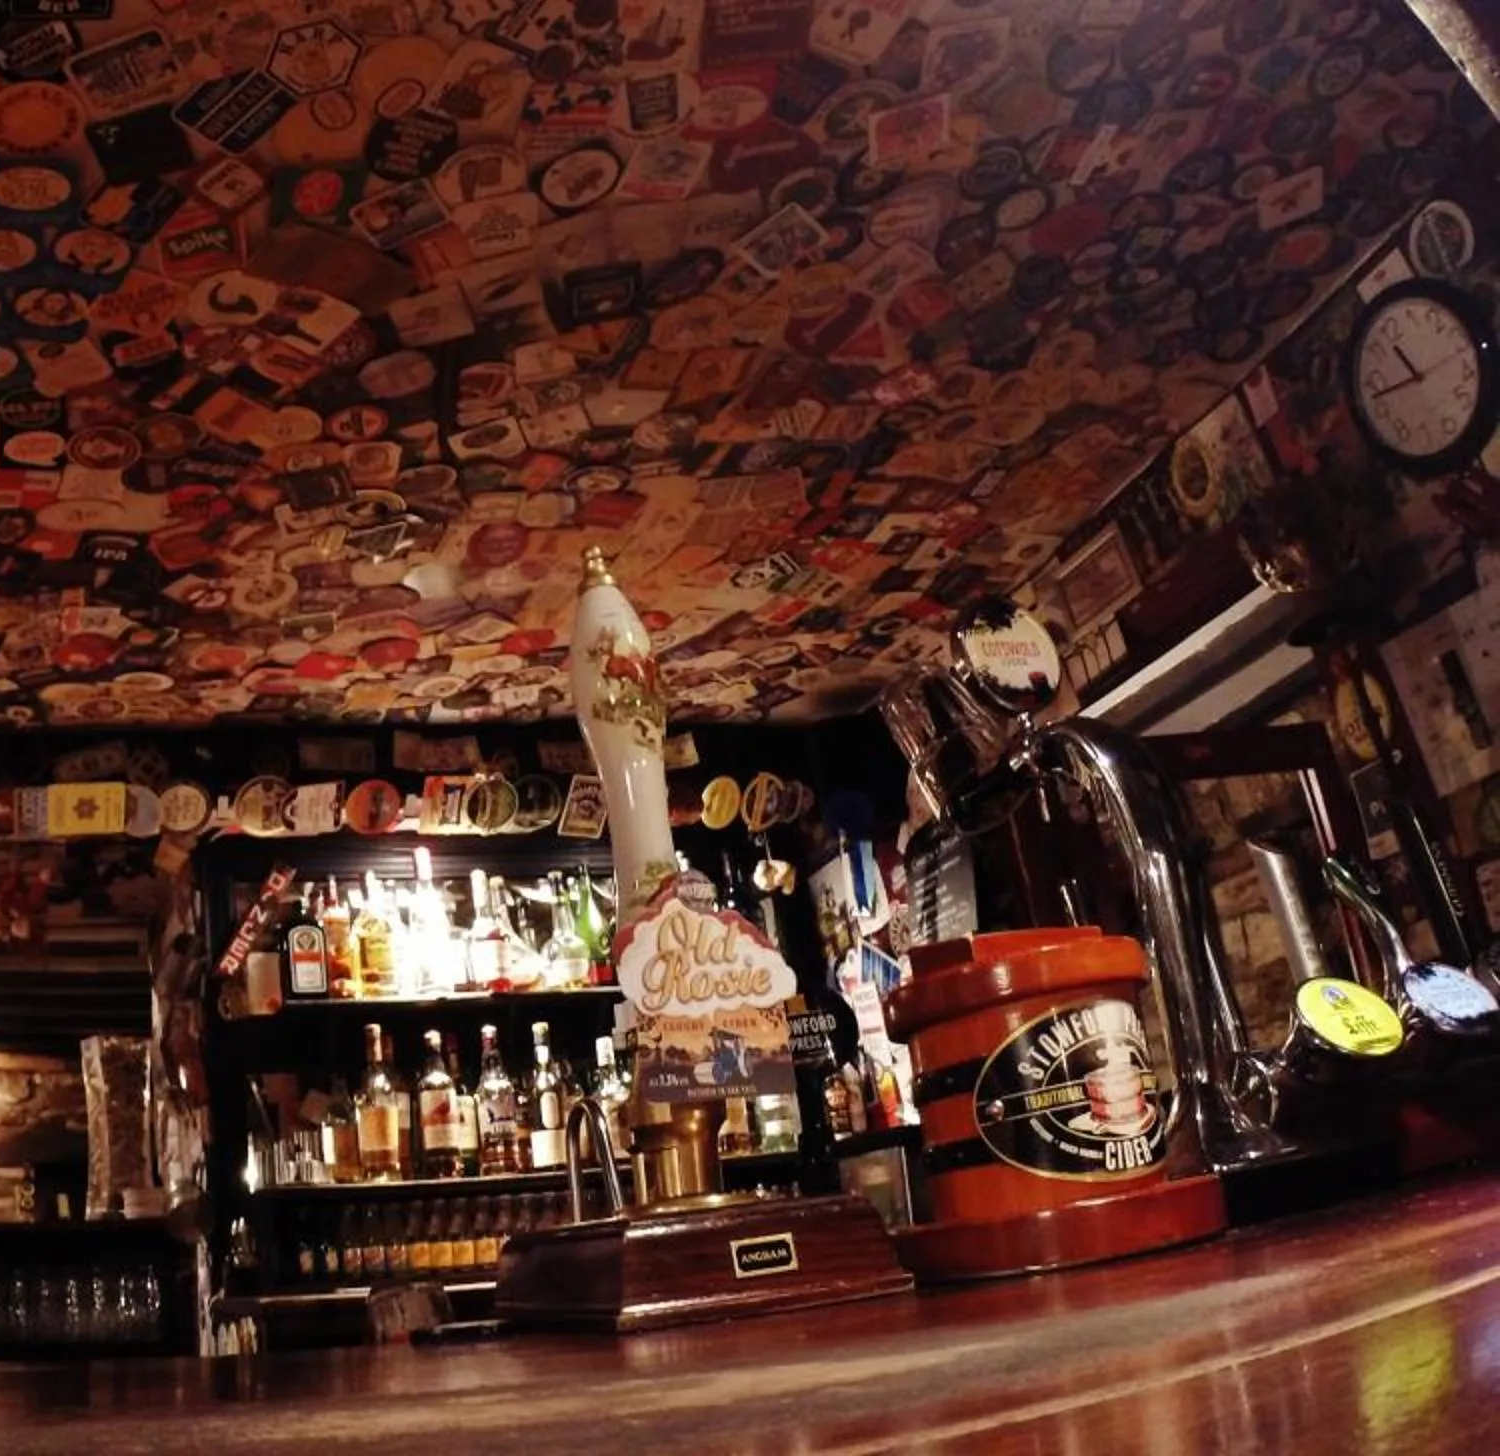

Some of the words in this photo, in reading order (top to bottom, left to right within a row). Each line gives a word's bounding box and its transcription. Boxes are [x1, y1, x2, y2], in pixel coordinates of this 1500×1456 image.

[657, 911, 740, 966] Old
[641, 951, 772, 1012] Rosie
[789, 1014, 837, 1035] WFORD
[1104, 1134, 1154, 1171] CIDER
[740, 1249, 790, 1264] ANGRAM
